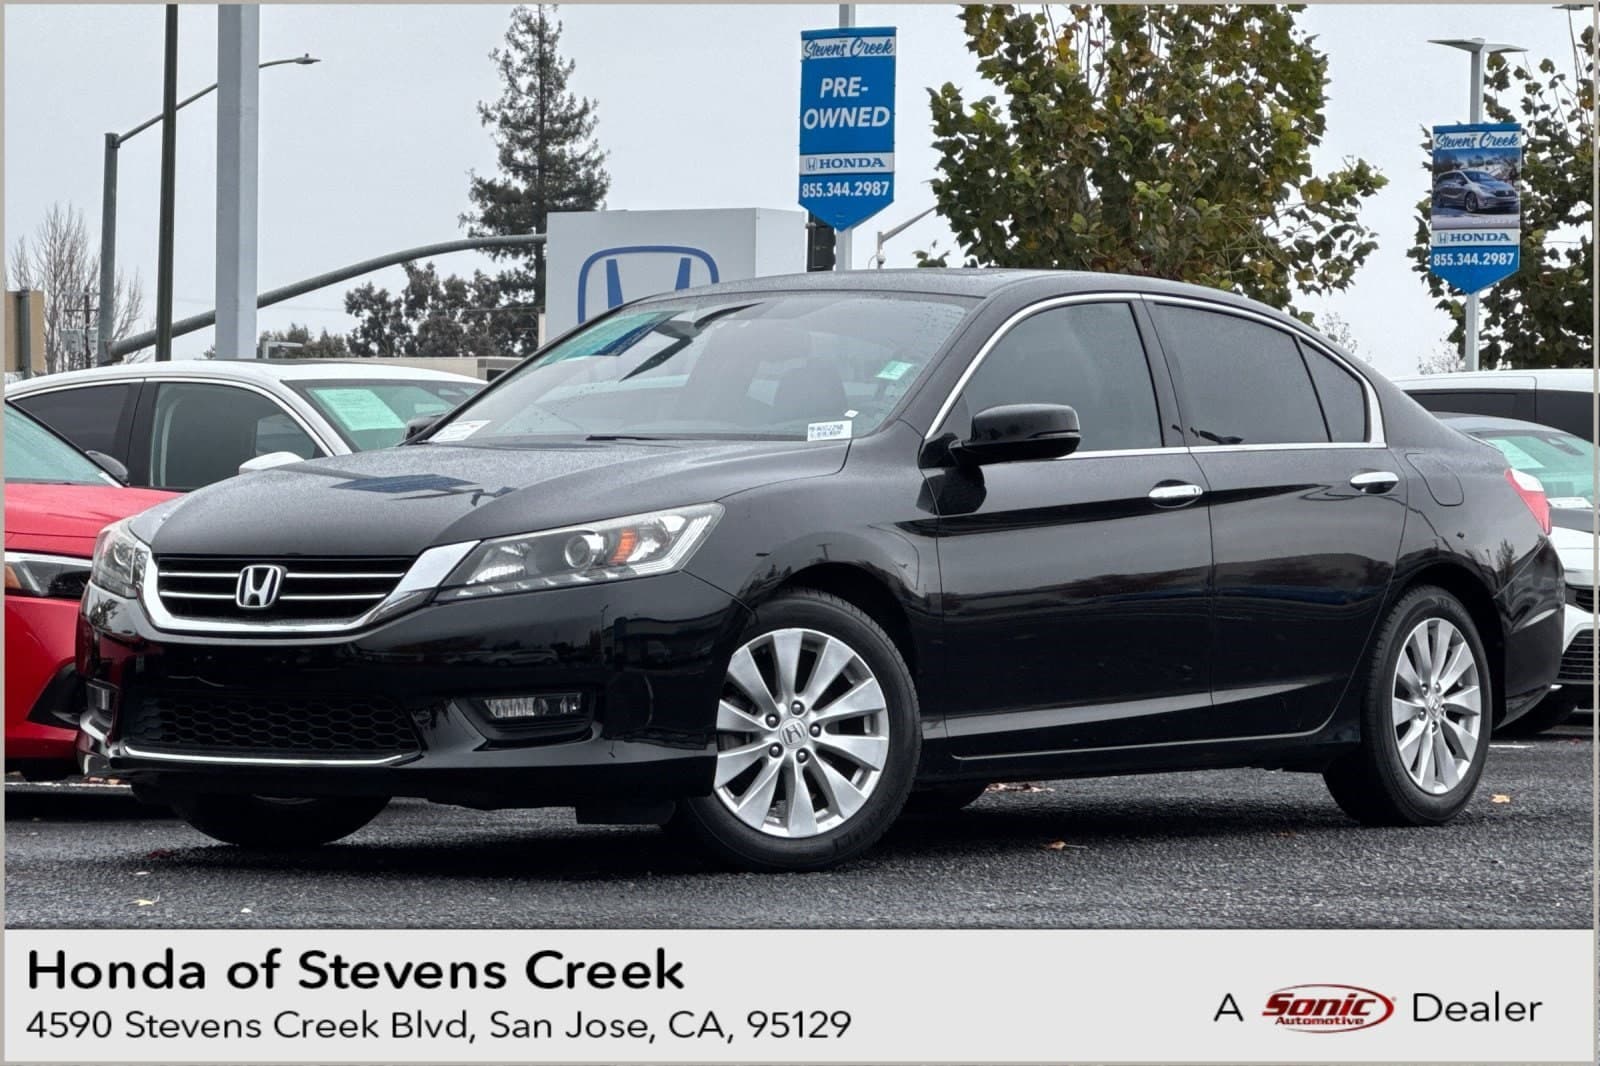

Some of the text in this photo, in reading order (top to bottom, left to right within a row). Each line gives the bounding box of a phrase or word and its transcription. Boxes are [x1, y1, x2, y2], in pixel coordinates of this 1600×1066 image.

[804, 37, 894, 60] Stevens Creek
[820, 76, 869, 98] PRE-
[803, 106, 890, 130] OWNED
[1435, 131, 1519, 150] Stevens Creek
[819, 158, 885, 169] HONDA
[802, 181, 890, 198] 855.344.2987
[1451, 232, 1510, 242] HONDA
[1433, 252, 1514, 266] 855.344.2987
